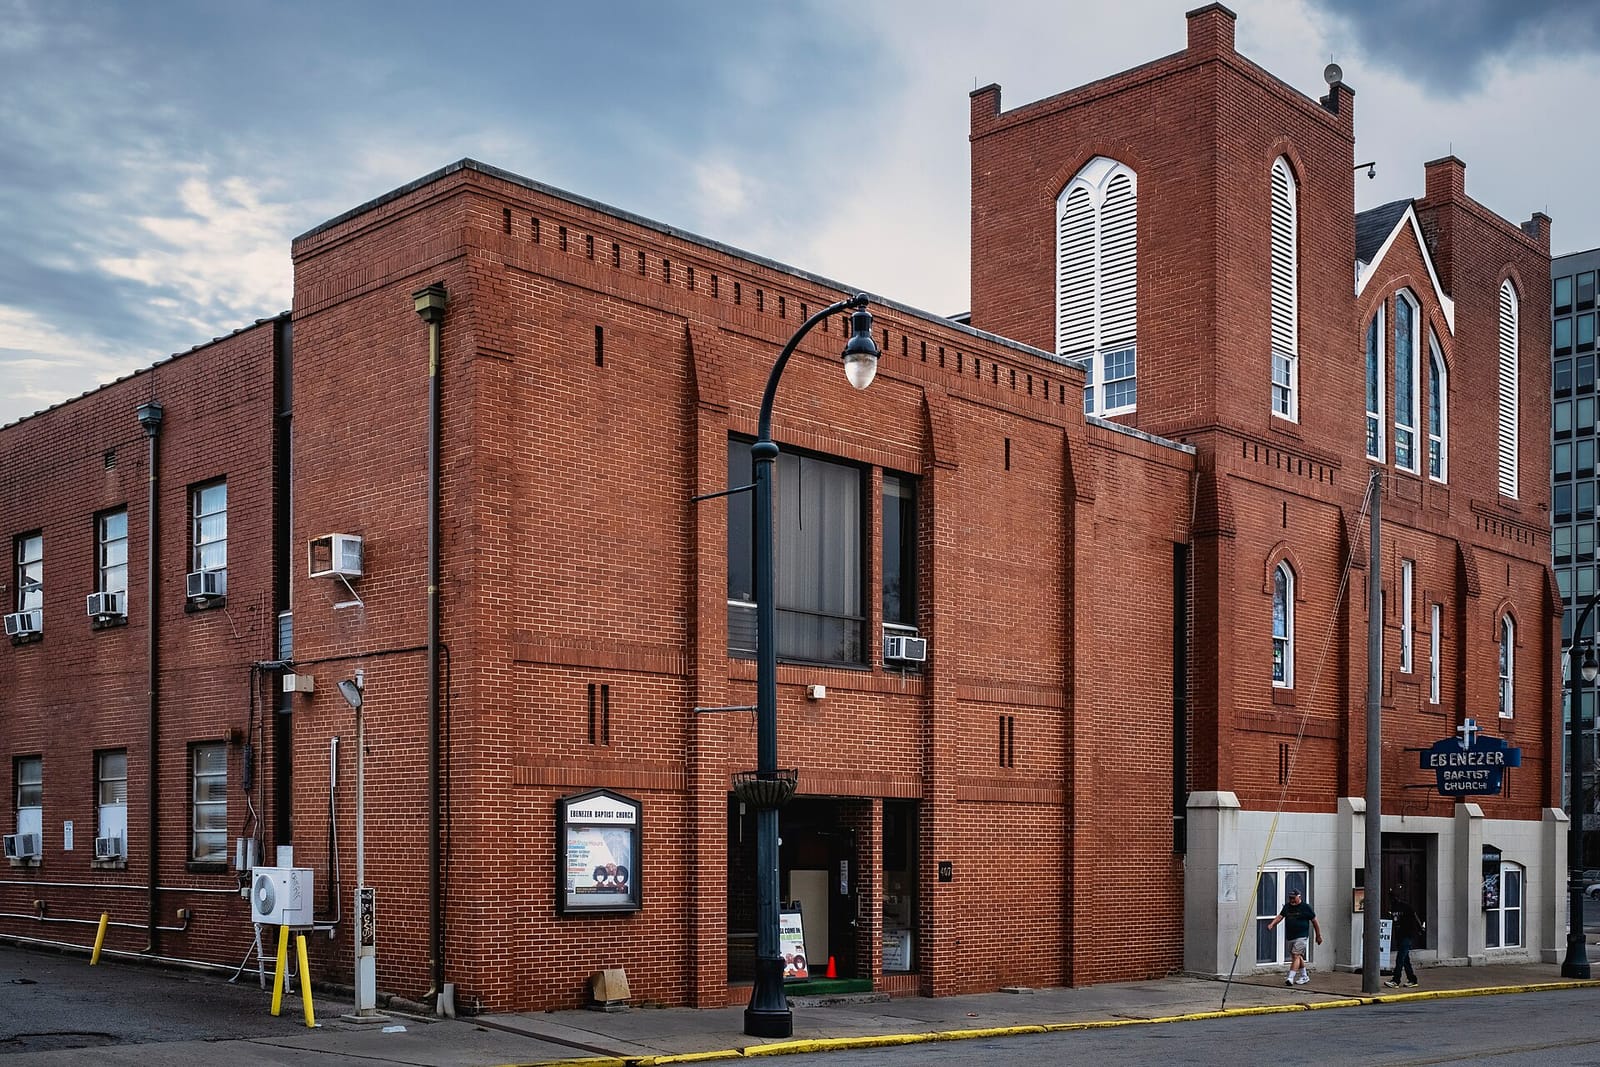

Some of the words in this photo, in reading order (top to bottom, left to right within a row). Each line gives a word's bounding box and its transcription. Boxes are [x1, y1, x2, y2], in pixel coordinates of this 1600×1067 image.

[1430, 752, 1504, 767] EBENEZER
[1443, 770, 1490, 780] BAPTIST
[1444, 781, 1488, 791] CHURCH
[570, 810, 592, 818] EBENEZER
[594, 810, 614, 818] BAPTIST
[616, 811, 634, 819] CHURCH
